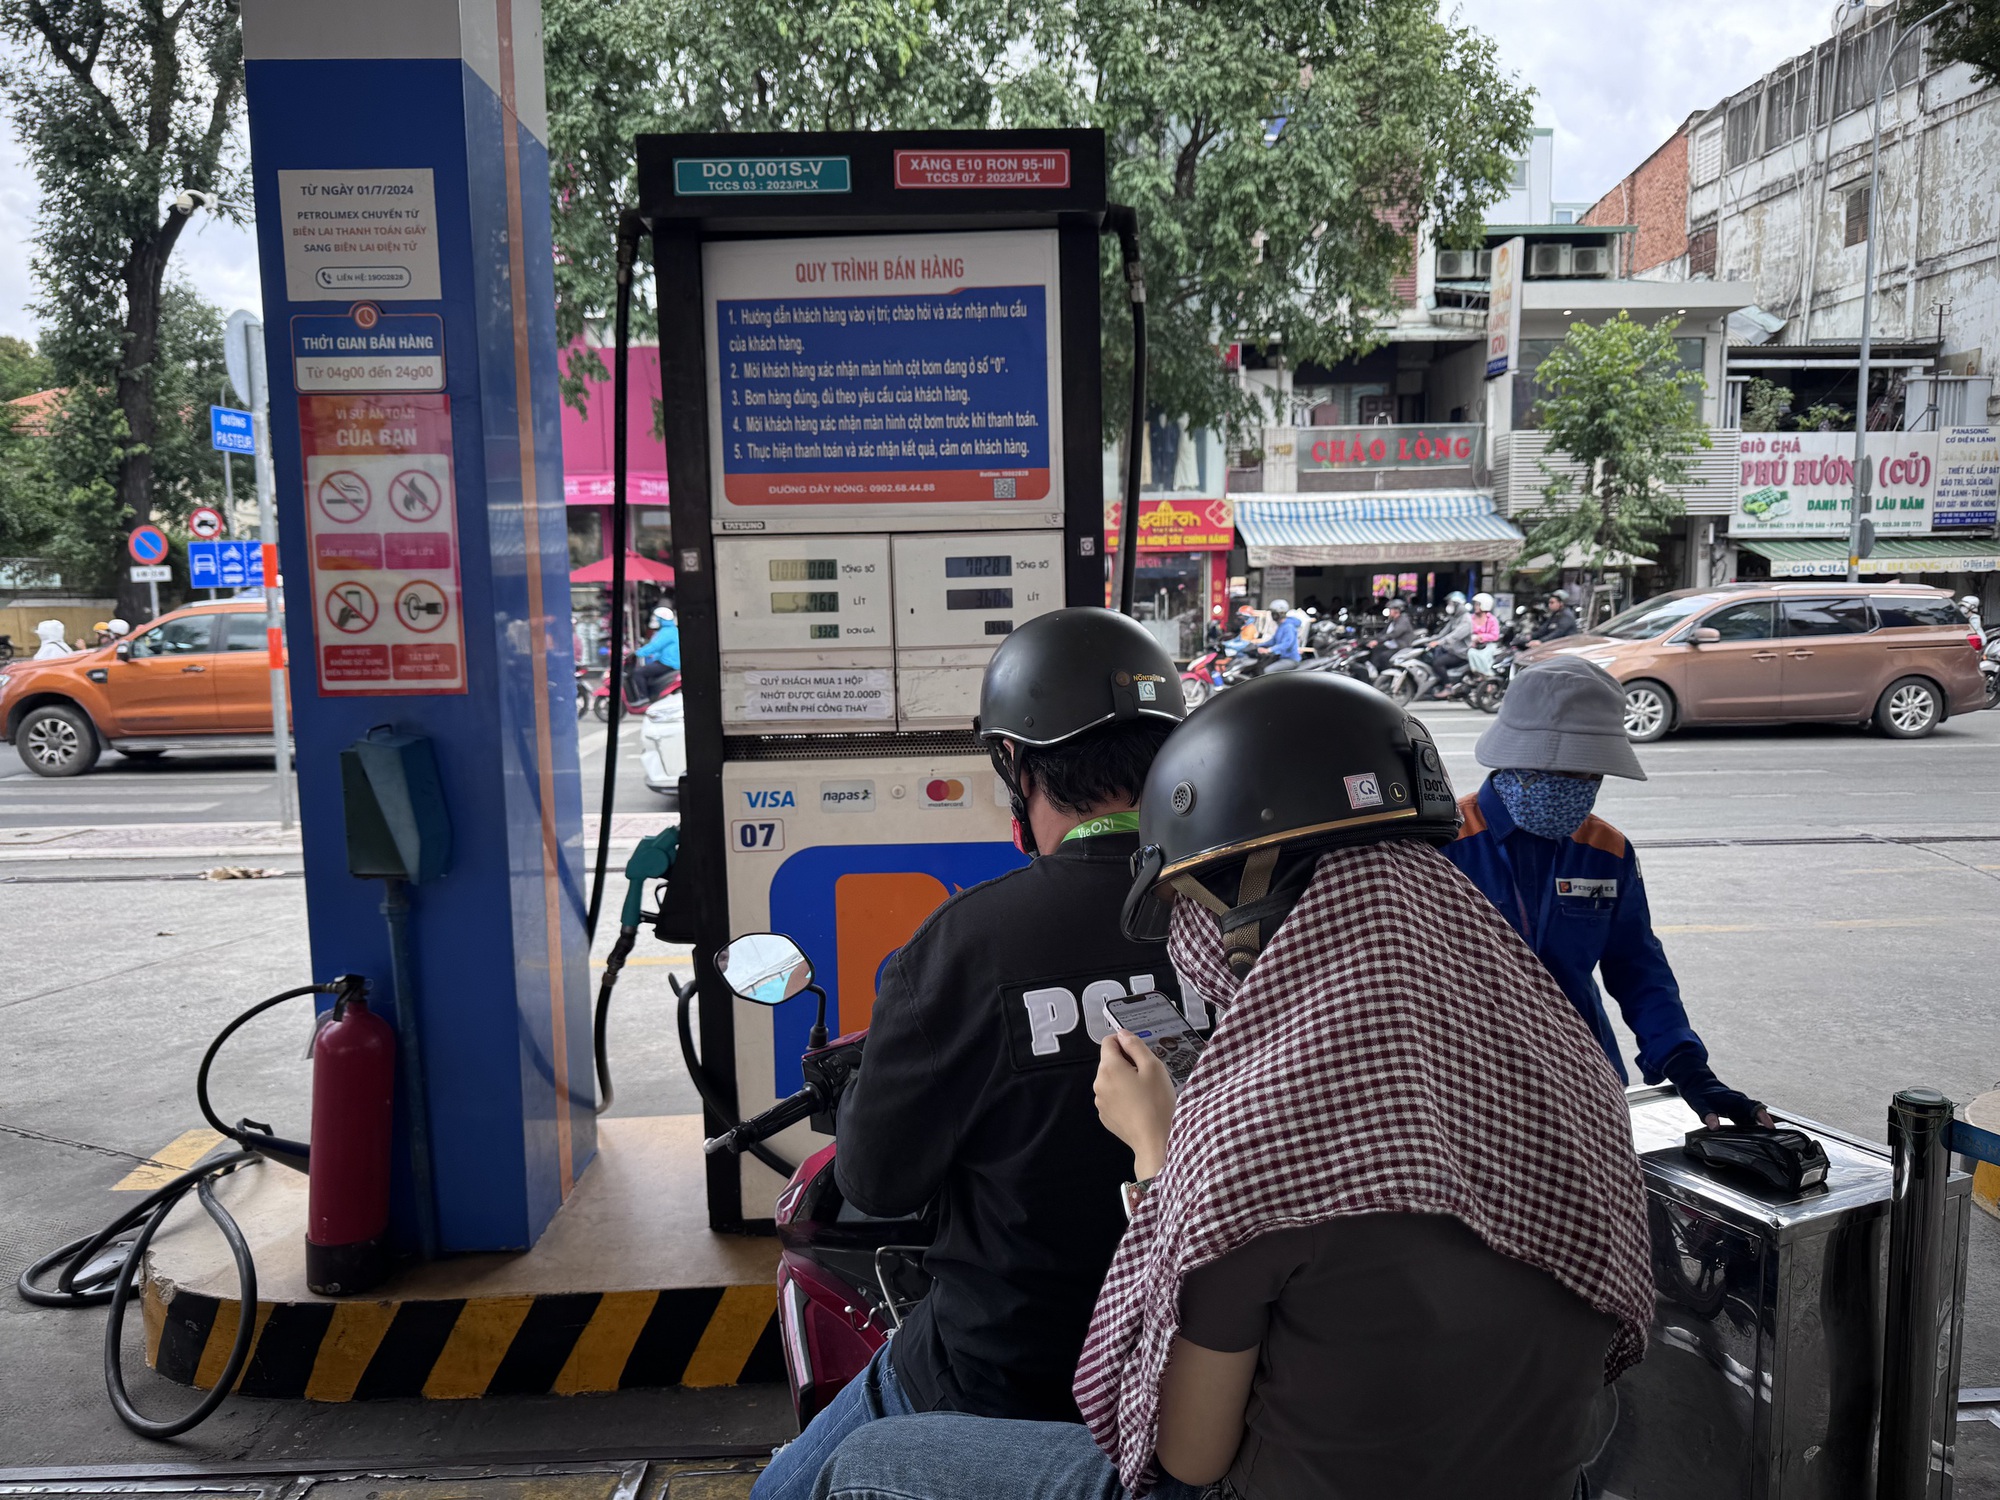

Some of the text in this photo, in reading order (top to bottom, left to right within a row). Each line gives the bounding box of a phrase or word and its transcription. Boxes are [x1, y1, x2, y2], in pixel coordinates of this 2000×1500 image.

[703, 161, 823, 179] DO 0,001S-V
[910, 156, 1056, 171] XĂNG E10 RON 95-III
[926, 171, 1041, 183] TCCS 07 2023/PLX
[301, 183, 414, 196] TỪ NGÀY 01/7/2024
[708, 179, 819, 191] TCCS 03 2023/PLX
[297, 211, 359, 220] PETROLIMEX
[293, 226, 315, 236] BIÊN
[318, 227, 333, 236] LAI
[336, 227, 371, 236] THANH
[374, 225, 402, 236] TOÁN
[304, 243, 331, 253] SANG
[334, 242, 356, 252] BIÊN
[360, 243, 375, 252] LAI
[796, 254, 965, 283] QUY TRÌNH BÁN HÀNG
[793, 307, 821, 324] khách
[823, 306, 847, 327] hàng
[990, 301, 1008, 318] nhu
[303, 334, 433, 350] THỜI GIAN BÁN HÀNG
[748, 334, 776, 351] khách
[306, 365, 433, 382] Từ 04g00 đến 24g00
[762, 361, 790, 378] khách
[792, 361, 816, 381] hàng
[768, 388, 792, 409] hàng
[836, 388, 857, 404] theo
[915, 386, 943, 402] khách
[764, 416, 793, 432] khách
[795, 415, 818, 436] hàng
[971, 412, 986, 428] khi
[988, 411, 1014, 427] thanh
[336, 422, 417, 449] CỦA BẠN
[795, 442, 821, 458] thanh
[823, 441, 843, 458] toán
[974, 438, 1002, 455] khách
[1311, 433, 1387, 463] CHÁO
[1397, 431, 1471, 461] LÒNG
[1740, 453, 1788, 486] PHÚ
[1792, 454, 1857, 486] HƯƠN
[869, 483, 935, 494] 0902.68.44.88
[1807, 499, 1838, 511] DANH
[724, 522, 764, 530] TATSUNO
[853, 596, 866, 605] LÍT
[1027, 592, 1040, 601] LÍT
[782, 676, 811, 685] KHÁCH
[814, 677, 835, 685] MUA
[843, 690, 881, 699] 20.000Đ
[761, 704, 773, 713] VÀ
[801, 703, 815, 713] PHÍ
[845, 704, 868, 713] THAY
[1424, 778, 1443, 792] DOT
[743, 790, 796, 808] VISA
[823, 790, 860, 804] napas
[740, 823, 775, 848] 07
